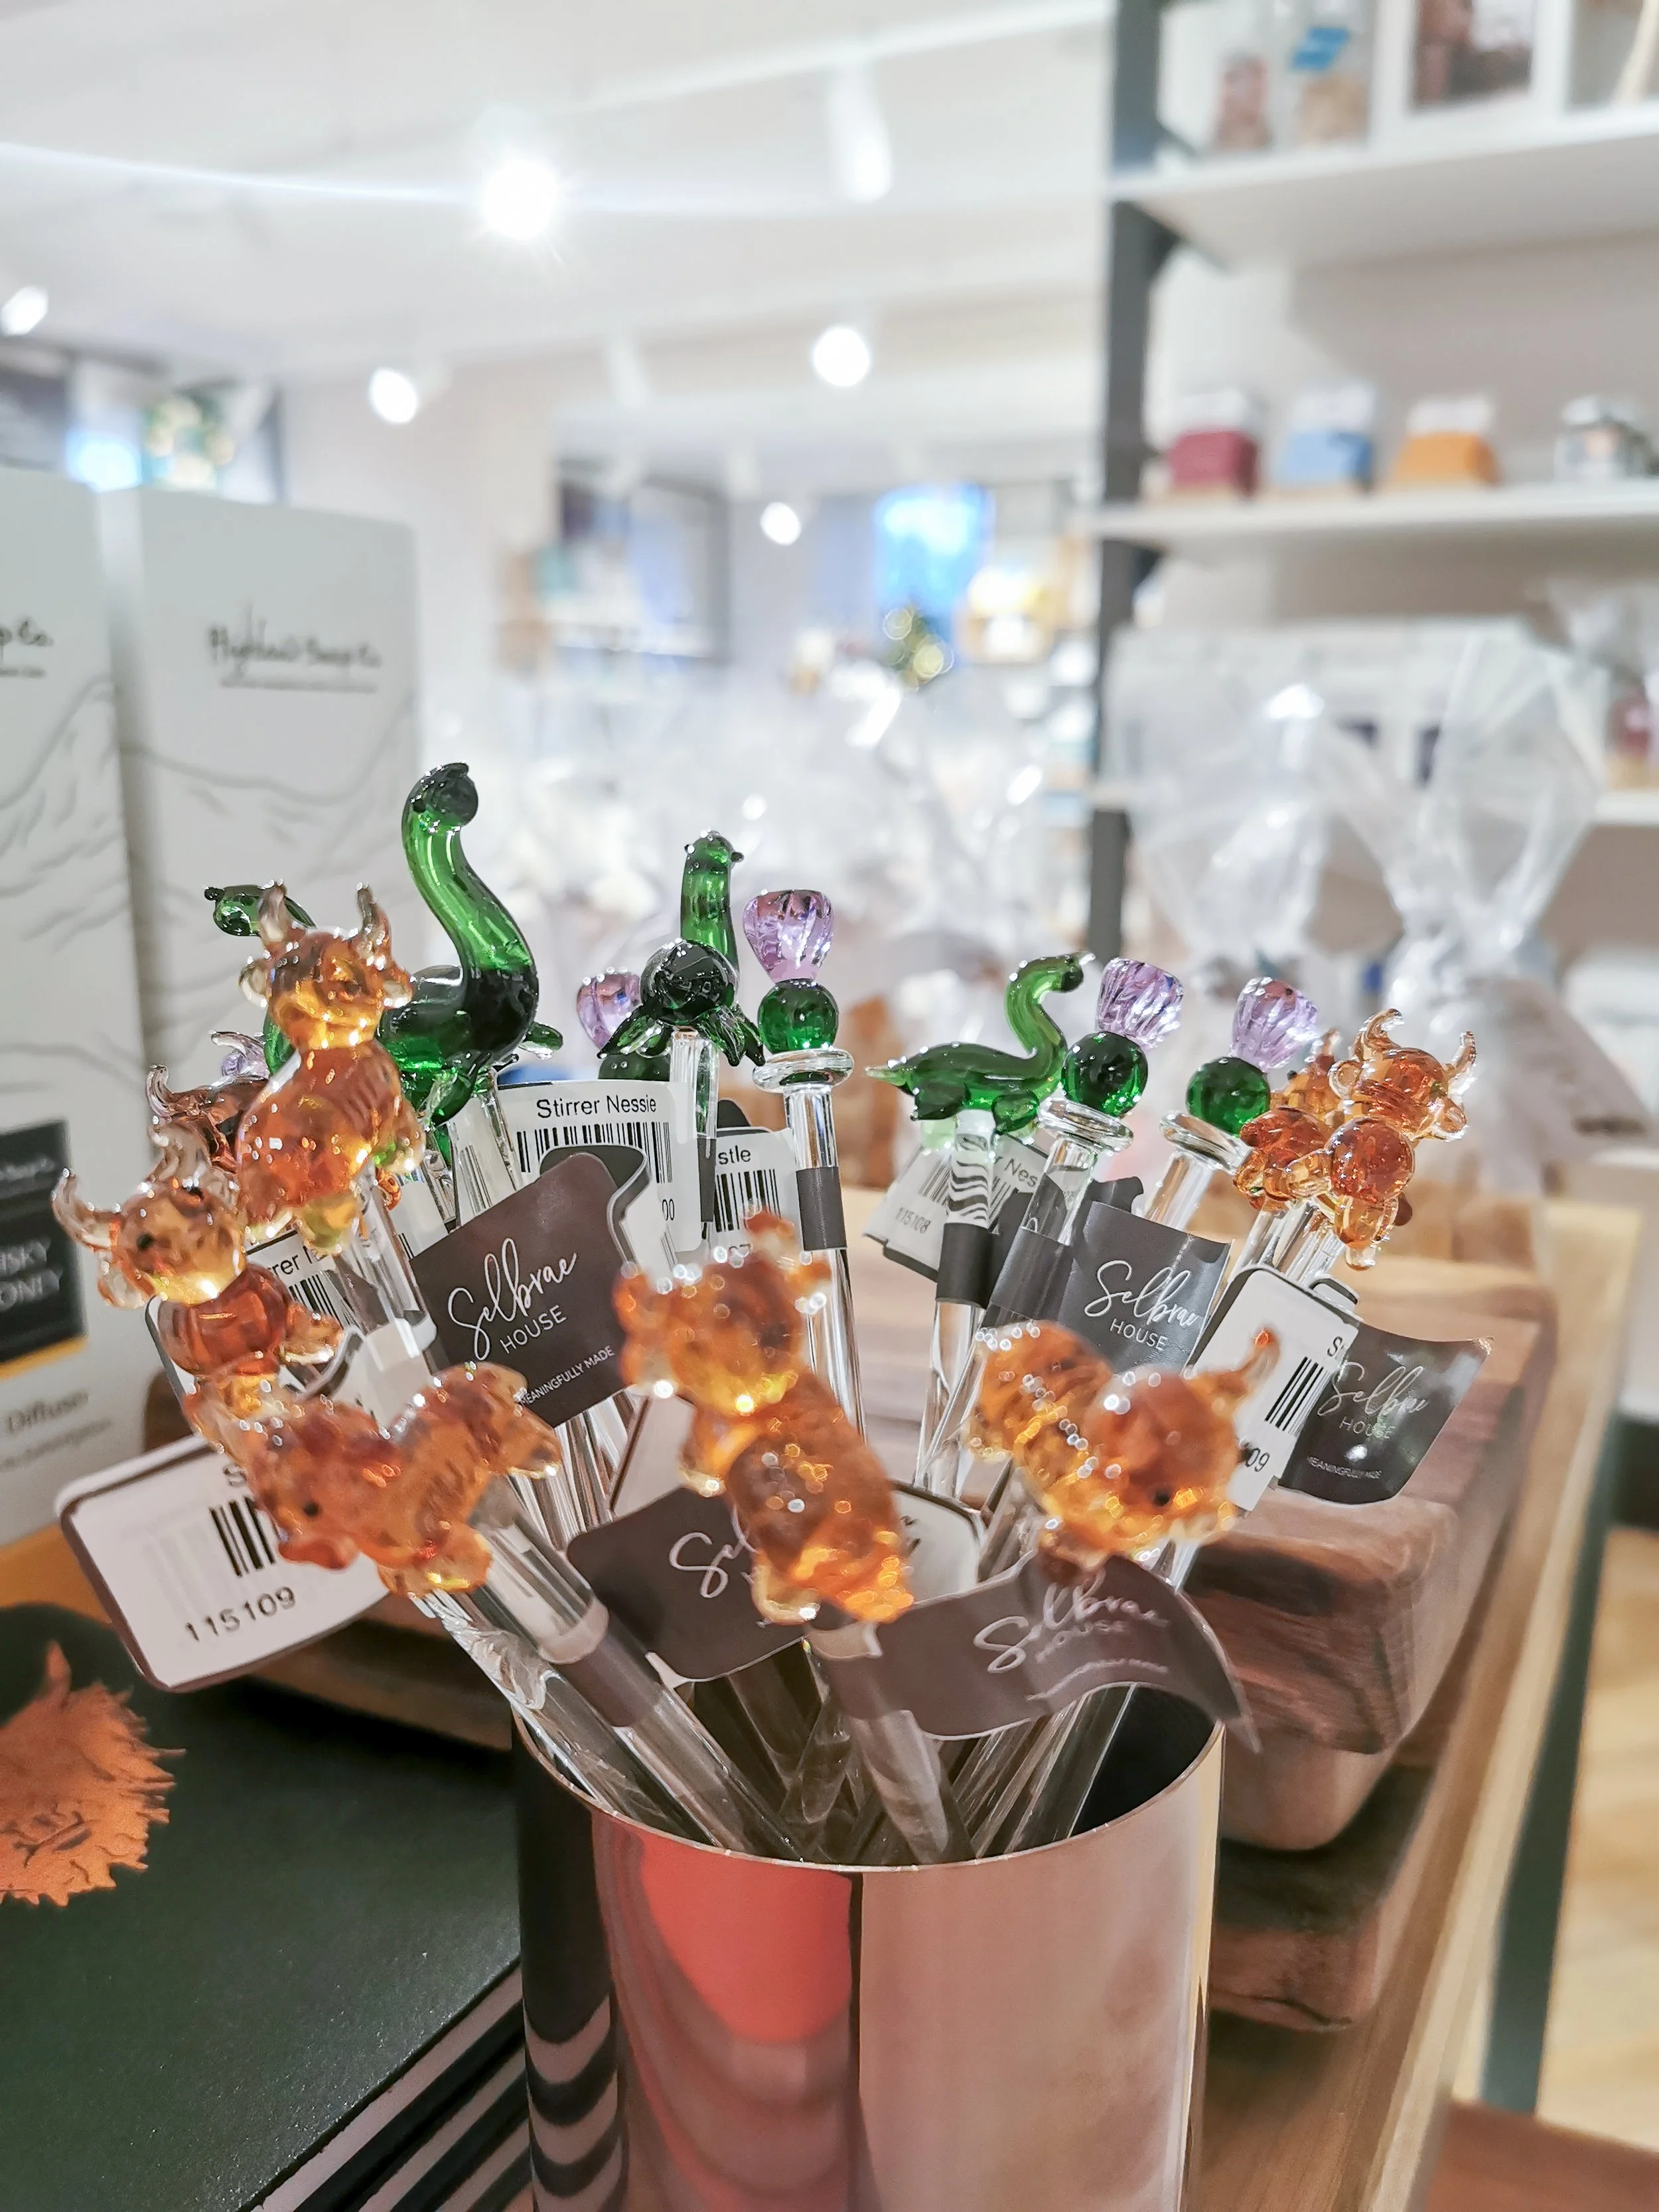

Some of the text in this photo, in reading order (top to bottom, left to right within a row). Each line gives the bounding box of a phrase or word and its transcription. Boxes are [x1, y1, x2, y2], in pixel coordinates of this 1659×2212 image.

[536, 1094, 657, 1119] Stirrer Nessie
[717, 1144, 751, 1165] stle
[1004, 1157, 1039, 1188] Nes
[447, 1237, 577, 1361] Selbrae
[1084, 1260, 1199, 1326] Selbrae
[500, 1304, 567, 1354] HOUSE
[1110, 1317, 1168, 1351] HOUSE
[583, 1345, 616, 1369] MADE
[185, 1585, 297, 1641] 115109
